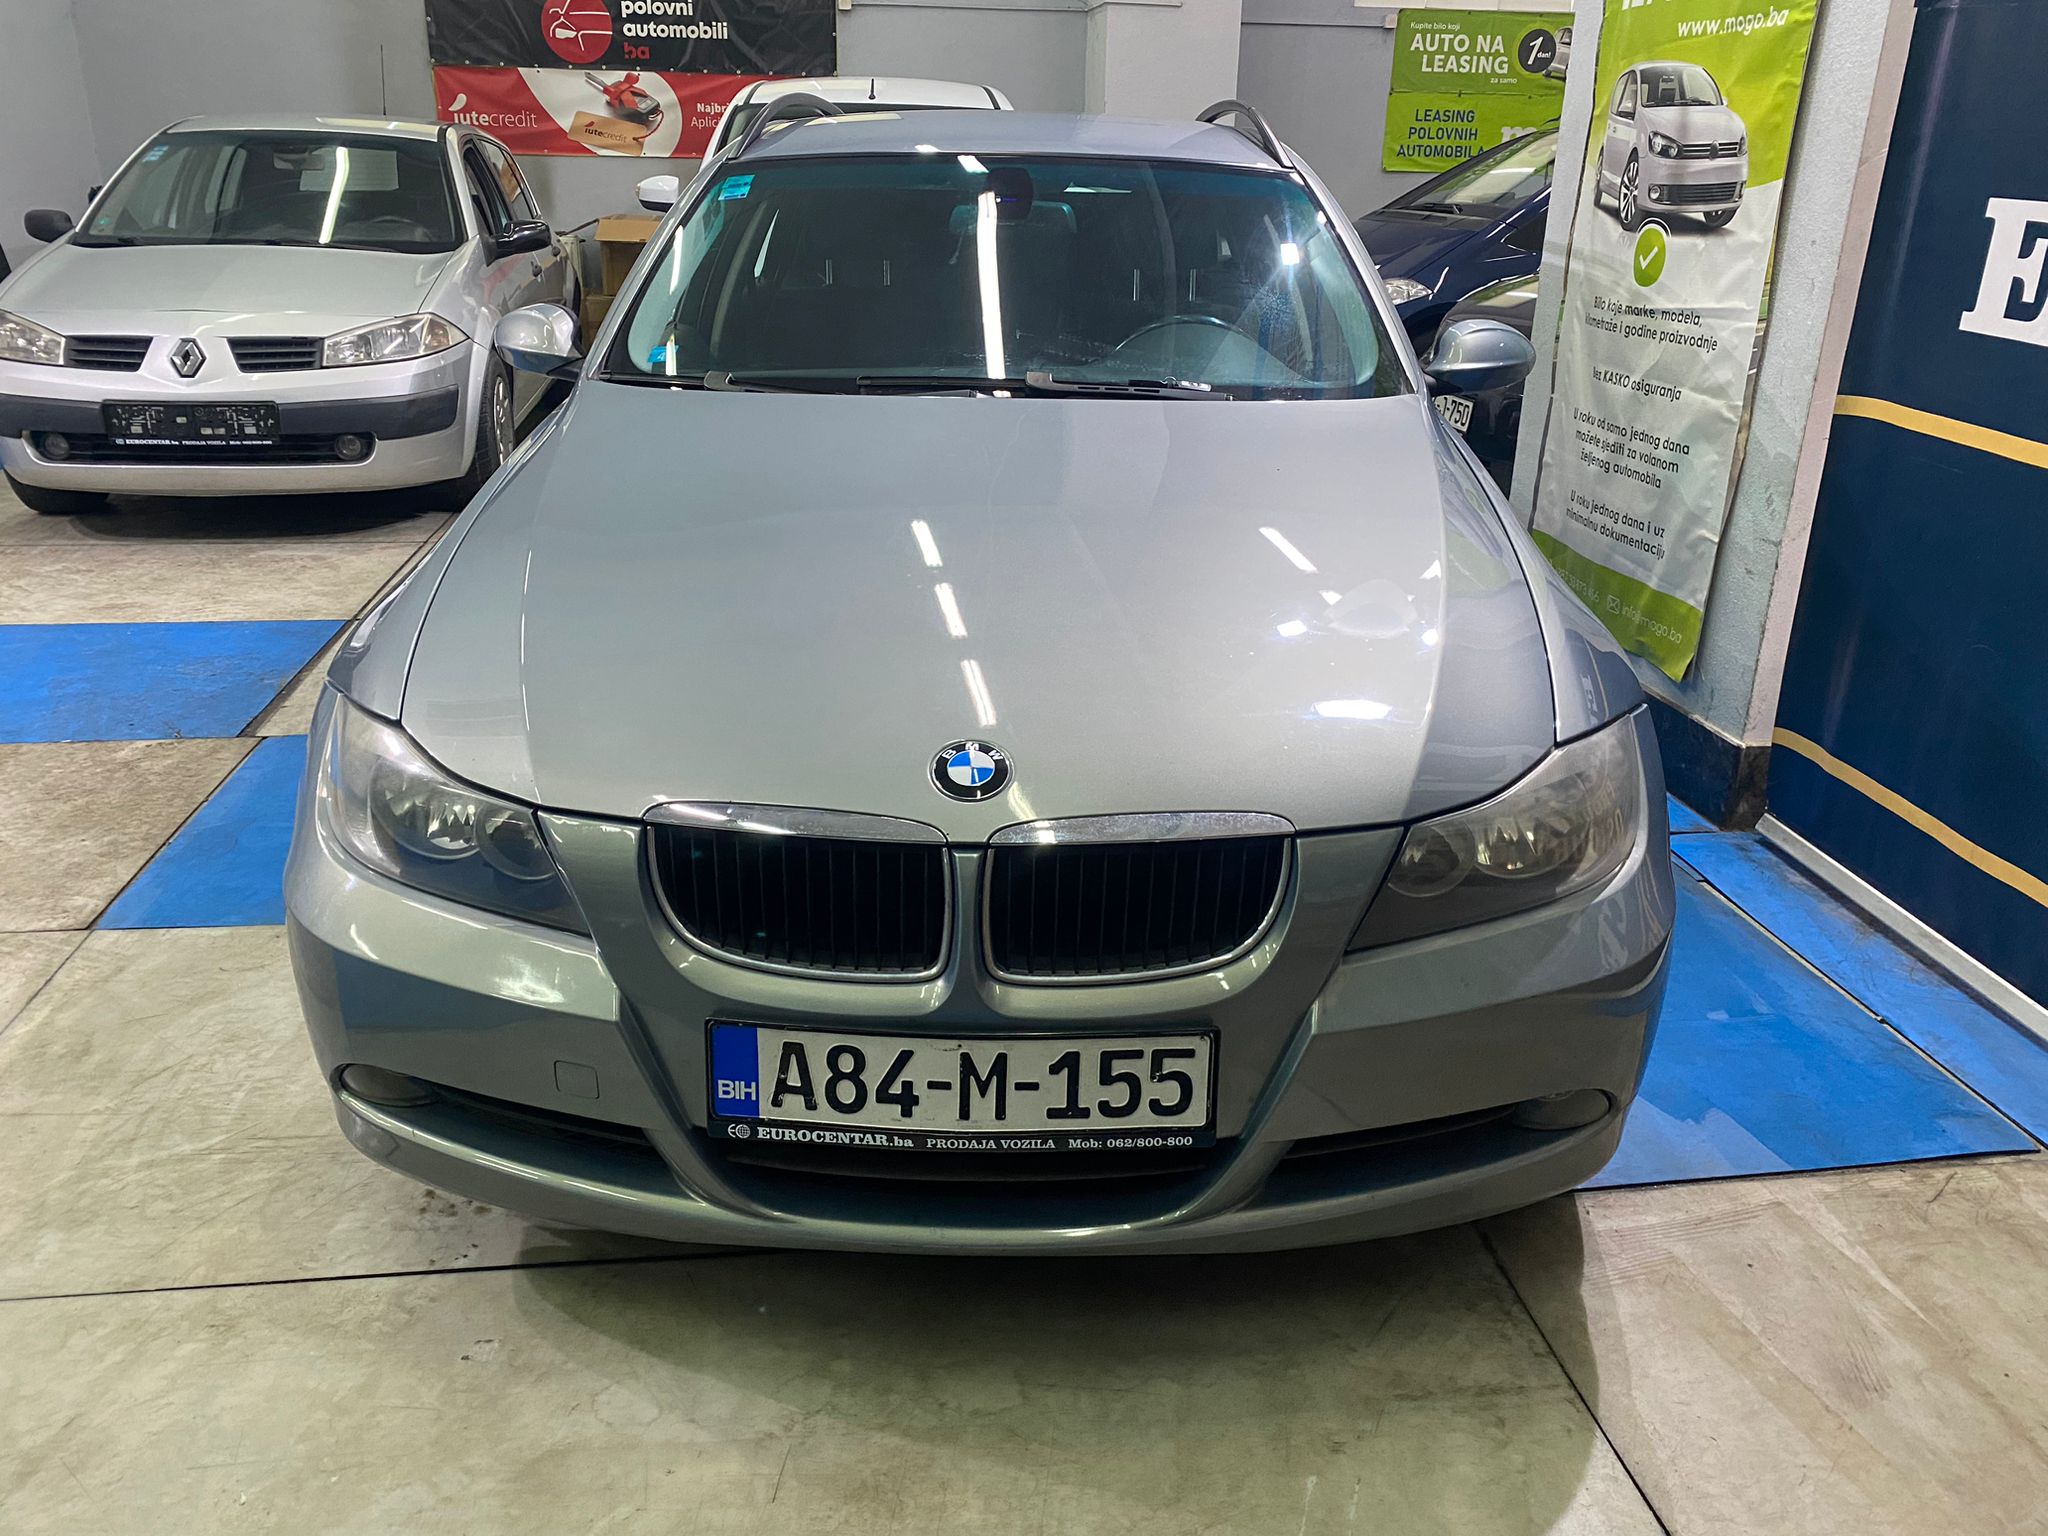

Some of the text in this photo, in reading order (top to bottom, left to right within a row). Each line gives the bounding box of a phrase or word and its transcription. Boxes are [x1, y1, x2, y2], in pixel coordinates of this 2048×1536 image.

[621, 0, 694, 18] polovni
[622, 21, 728, 39] automobili
[1410, 22, 1432, 30] Kupite
[1448, 23, 1460, 31] koji
[1678, 6, 1789, 37] www.mogo.ba
[624, 42, 650, 59] ba
[1410, 33, 1504, 53] AUTO NA
[1527, 36, 1543, 65] 1
[1421, 54, 1509, 74] LEASING
[451, 103, 538, 128] iutecredit
[1415, 109, 1475, 123] LEASING
[584, 123, 627, 143] iutecredit
[1408, 127, 1478, 141] POLOVNIH
[1594, 296, 1702, 327] Bilo koje marke, modela,
[1619, 321, 1623, 334] i
[1624, 324, 1657, 338] godine
[1659, 330, 1718, 353] proizvodnje
[1603, 370, 1630, 388] KASKO
[1631, 378, 1682, 402] osiguranja
[1573, 407, 1690, 455] U roku od samo jednog dana
[1576, 430, 1679, 473] možete sjediti za volanom
[1581, 448, 1661, 488] željenog automobila
[1571, 489, 1665, 538] U roku jednog dana i uz
[1566, 507, 1665, 560] minimalnu dokumentaciju
[941, 741, 1004, 761] BMW
[717, 1079, 756, 1101] BIH
[769, 1041, 1197, 1121] A84-M-155
[757, 1126, 1193, 1149] EUROCENTAR.ba PRODAJA VOZILA Mob: 062/800-800
